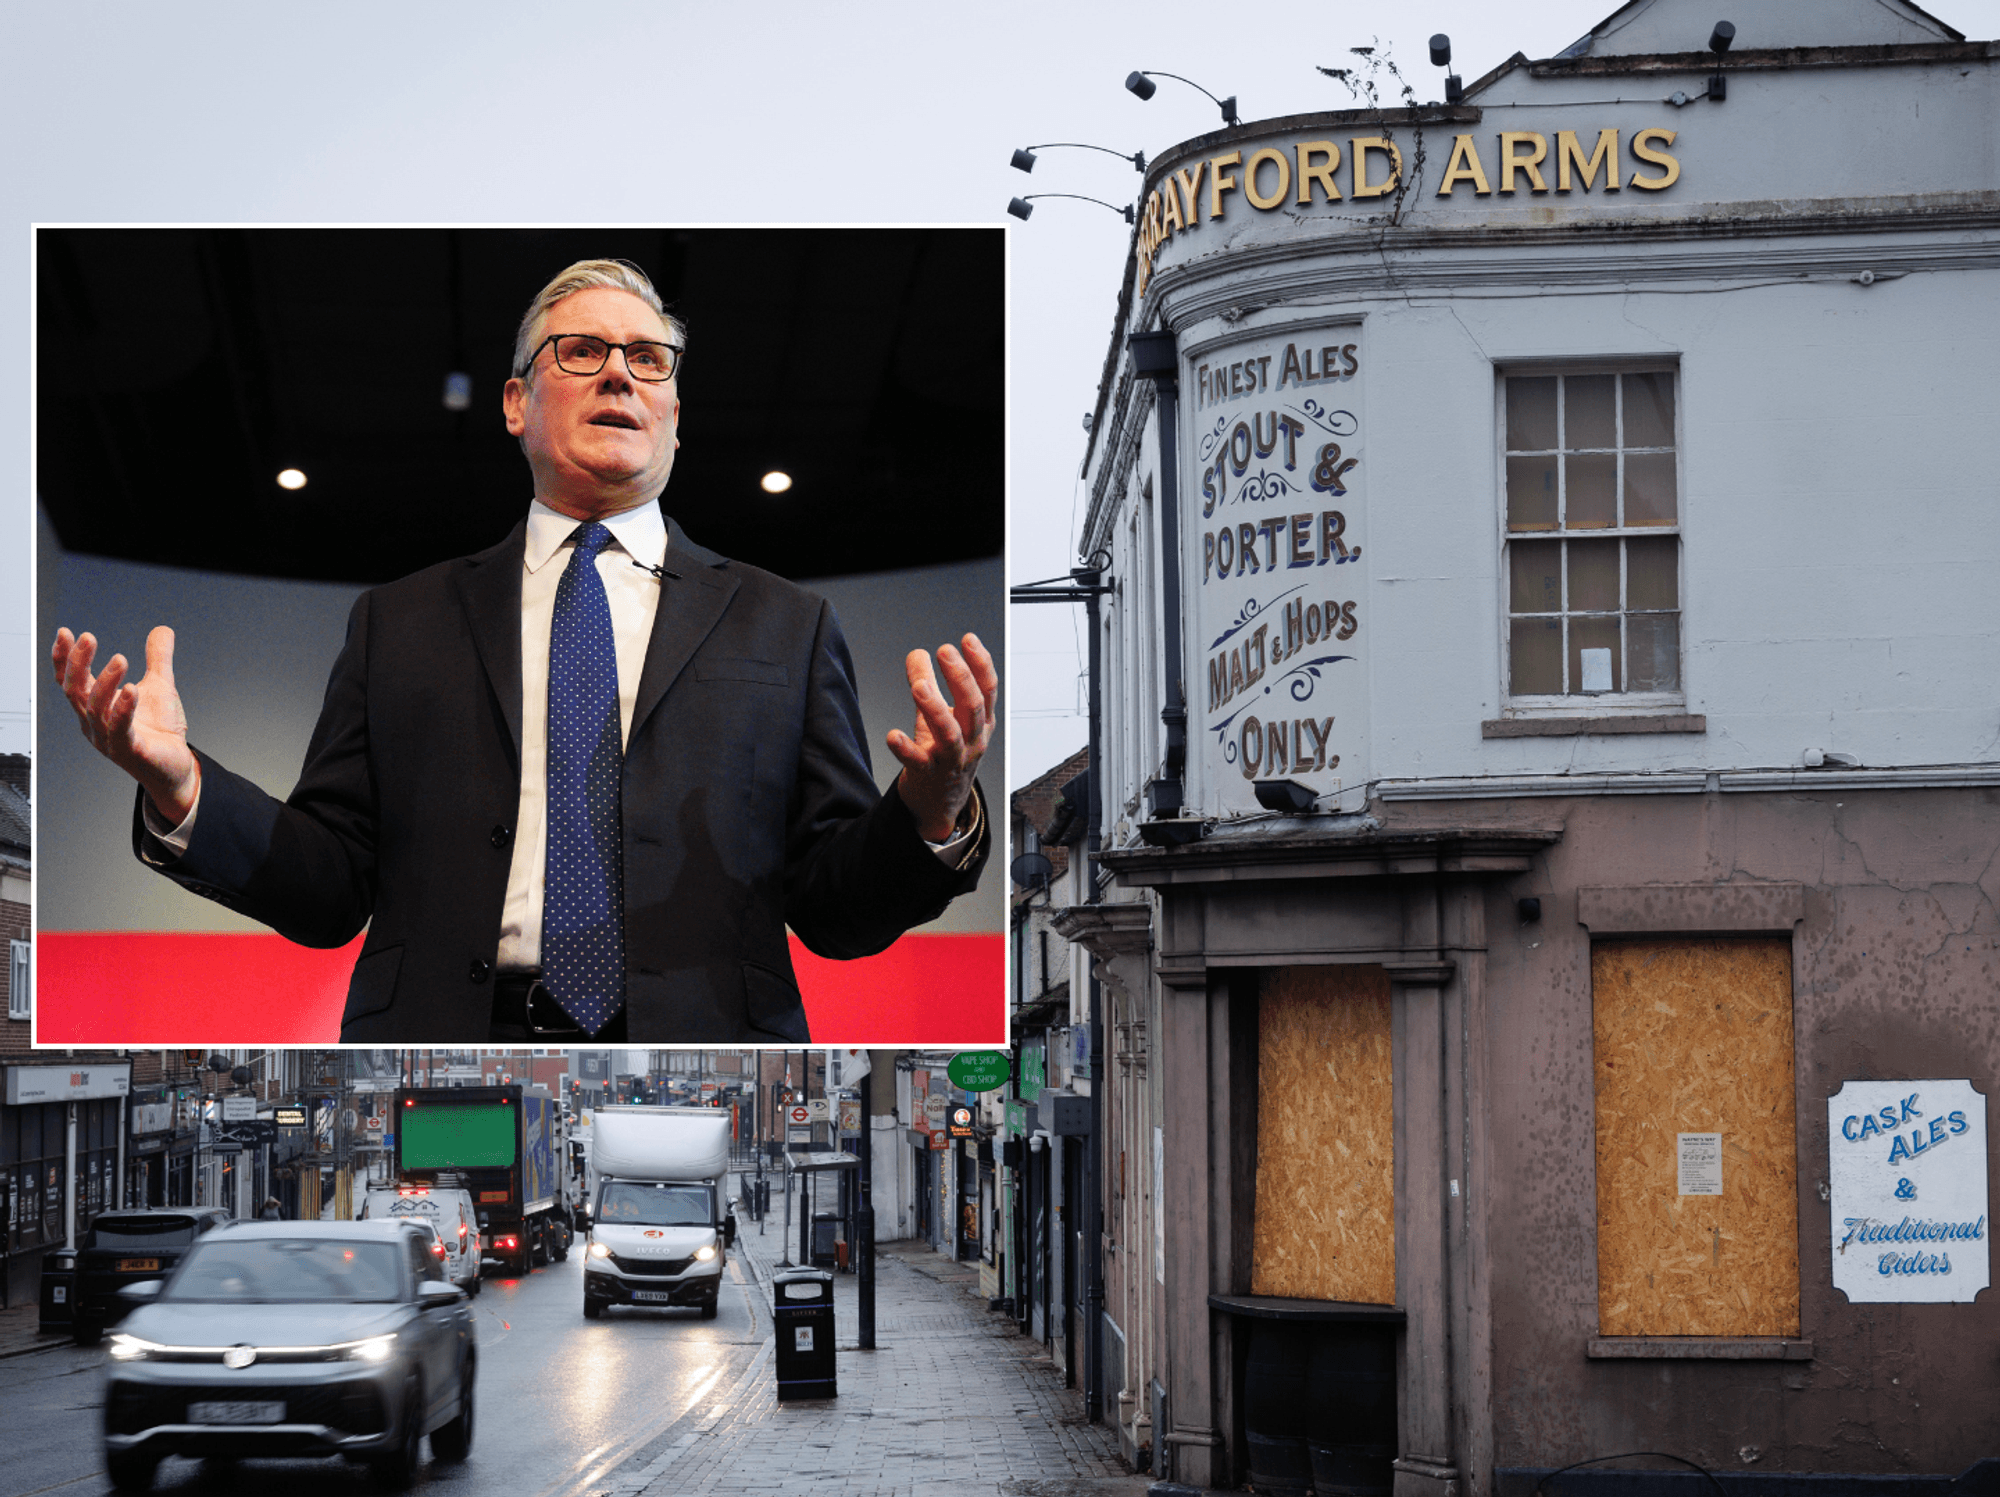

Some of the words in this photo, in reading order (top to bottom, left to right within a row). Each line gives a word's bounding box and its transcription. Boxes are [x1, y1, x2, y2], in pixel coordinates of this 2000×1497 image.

[1144, 137, 1404, 261] RAYFORD
[1436, 128, 1681, 199] ARMS
[1198, 355, 1272, 411] FINEST
[1275, 343, 1359, 391] ALES
[1202, 410, 1305, 518] STOUT
[1309, 442, 1359, 497] &
[1203, 510, 1362, 585] PORTER.
[1207, 622, 1268, 713] MALT
[1281, 596, 1358, 661] HOPS
[1238, 716, 1341, 780] ONLY.
[1841, 1093, 1923, 1142] CASK
[1888, 1110, 1970, 1166] ALES
[1894, 1177, 1918, 1202] &
[636, 1247, 671, 1256] IVECO
[1842, 1214, 1985, 1246] Traditional
[1877, 1250, 1951, 1278] Ciders
